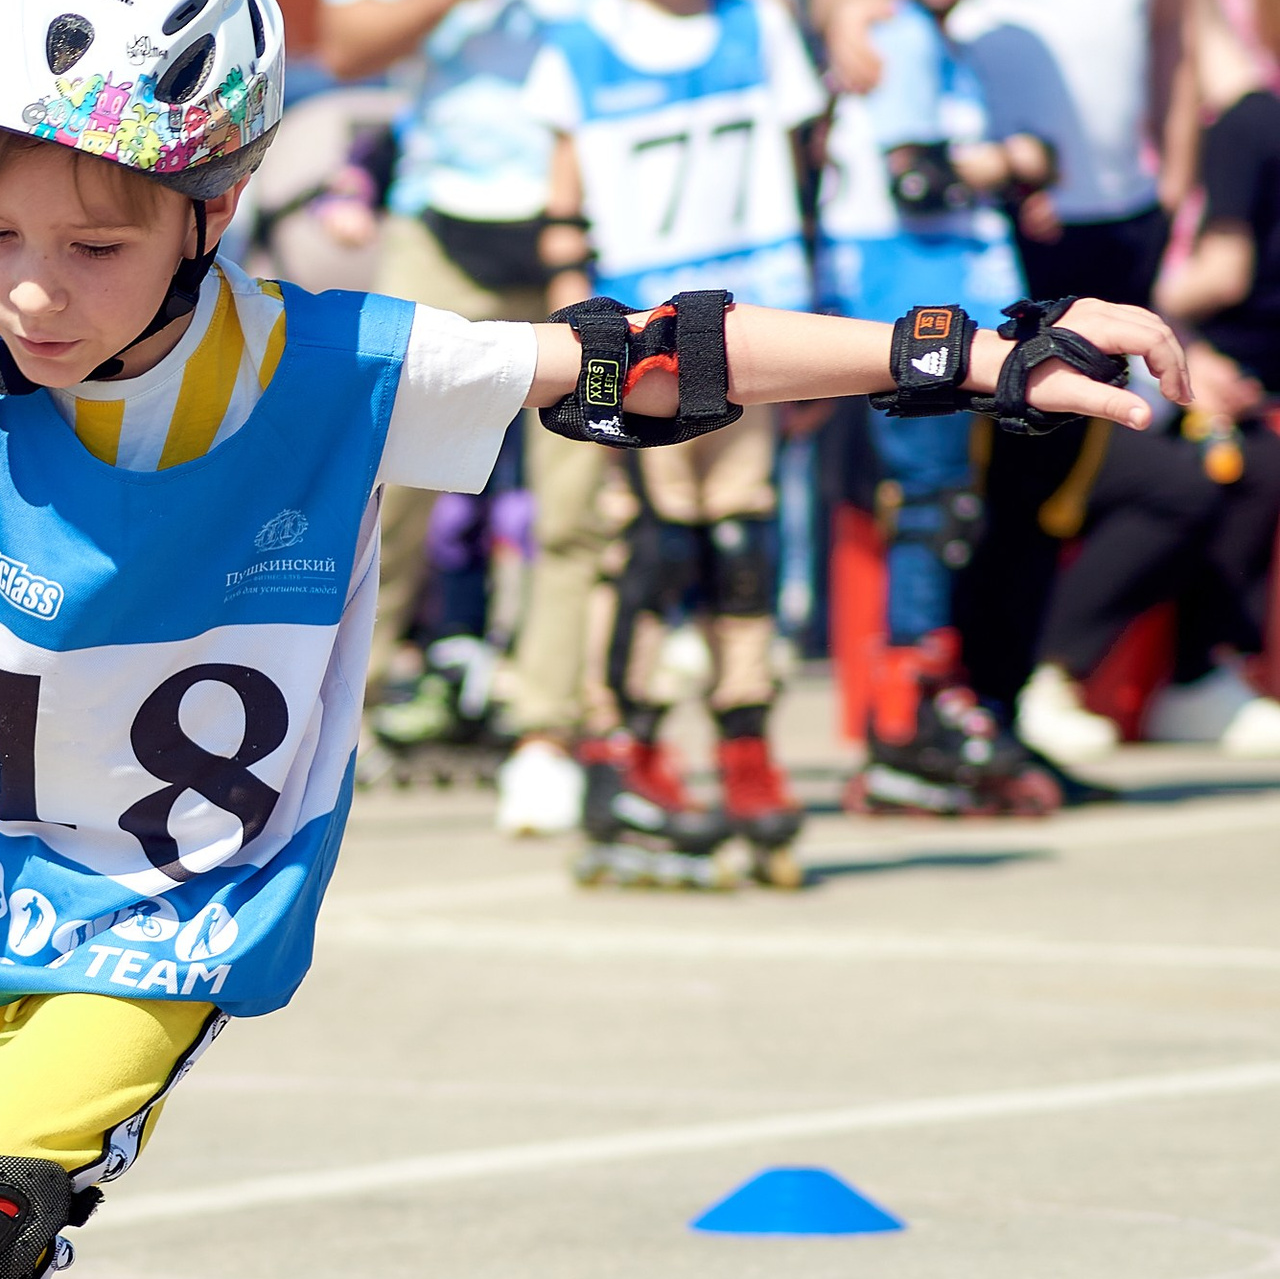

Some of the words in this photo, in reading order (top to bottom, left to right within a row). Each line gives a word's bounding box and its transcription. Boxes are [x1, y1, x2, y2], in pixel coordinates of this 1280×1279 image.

[631, 119, 756, 237] 77
[590, 365, 605, 399] XXXS
[604, 373, 616, 394] LEFT
[225, 557, 336, 587] Пушкинский
[85, 944, 232, 995] TEAM
